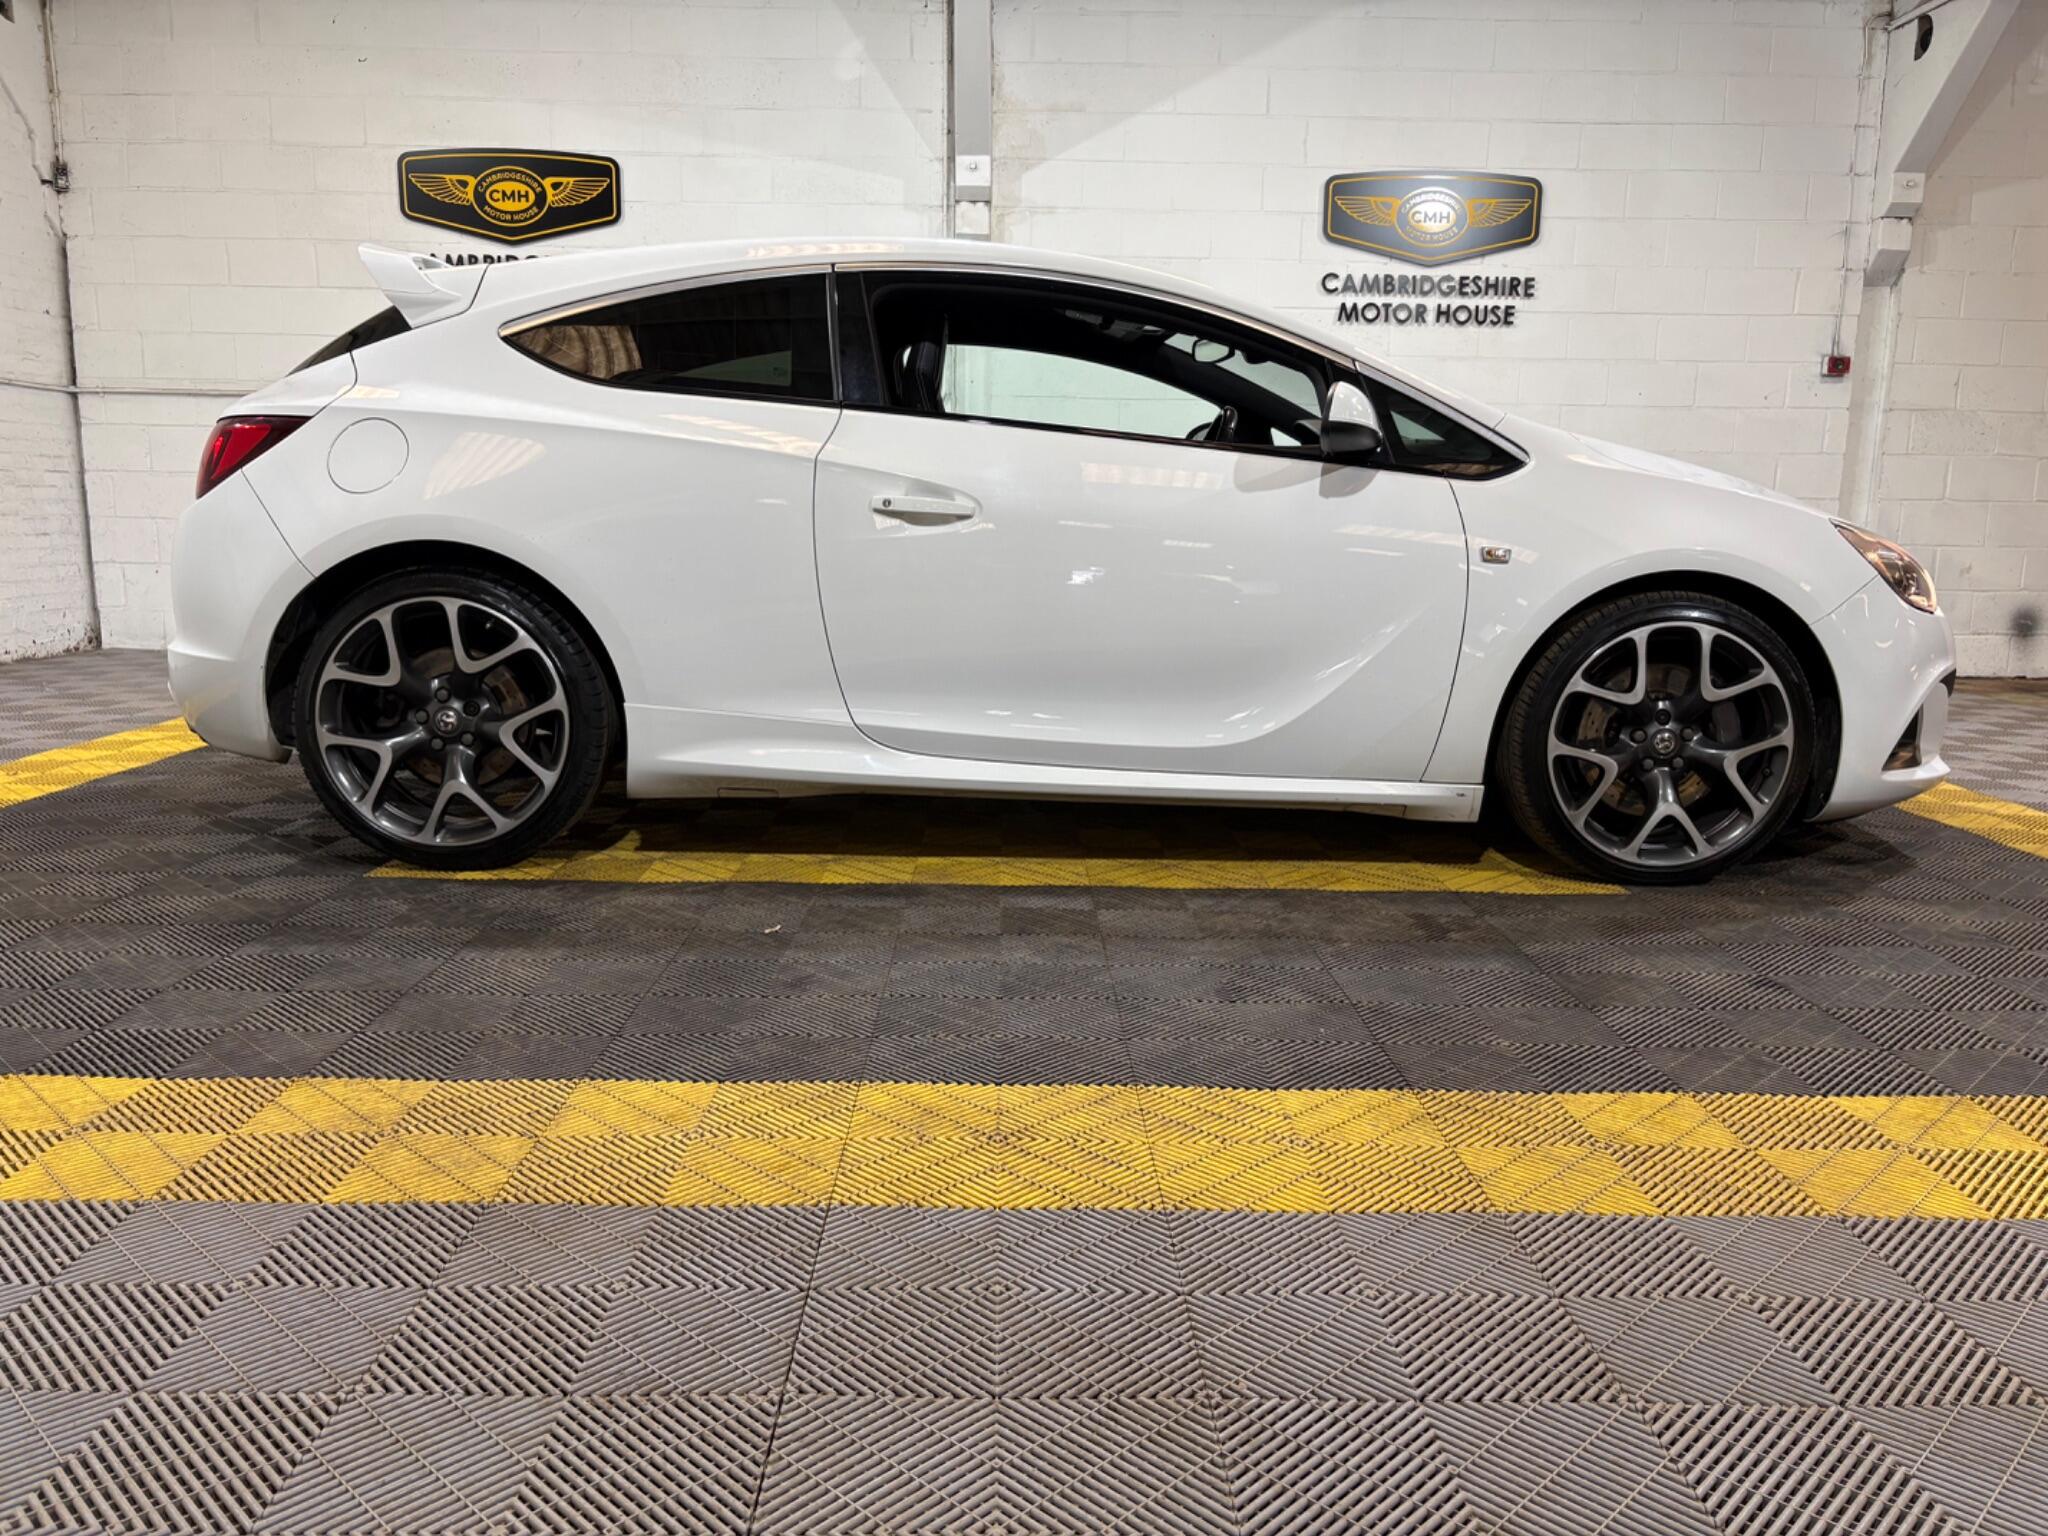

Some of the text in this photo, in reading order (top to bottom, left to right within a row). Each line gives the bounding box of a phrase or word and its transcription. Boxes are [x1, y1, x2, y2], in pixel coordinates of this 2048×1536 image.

[478, 172, 542, 193] CAMBRIDGESHIRE
[489, 189, 530, 203] CMH
[483, 205, 539, 221] MOTOR HOUSE
[1411, 210, 1451, 224] CMH
[1321, 272, 1536, 298] CAMBRIDGESHIRE
[1337, 302, 1516, 326] MOTOR HOUSE
